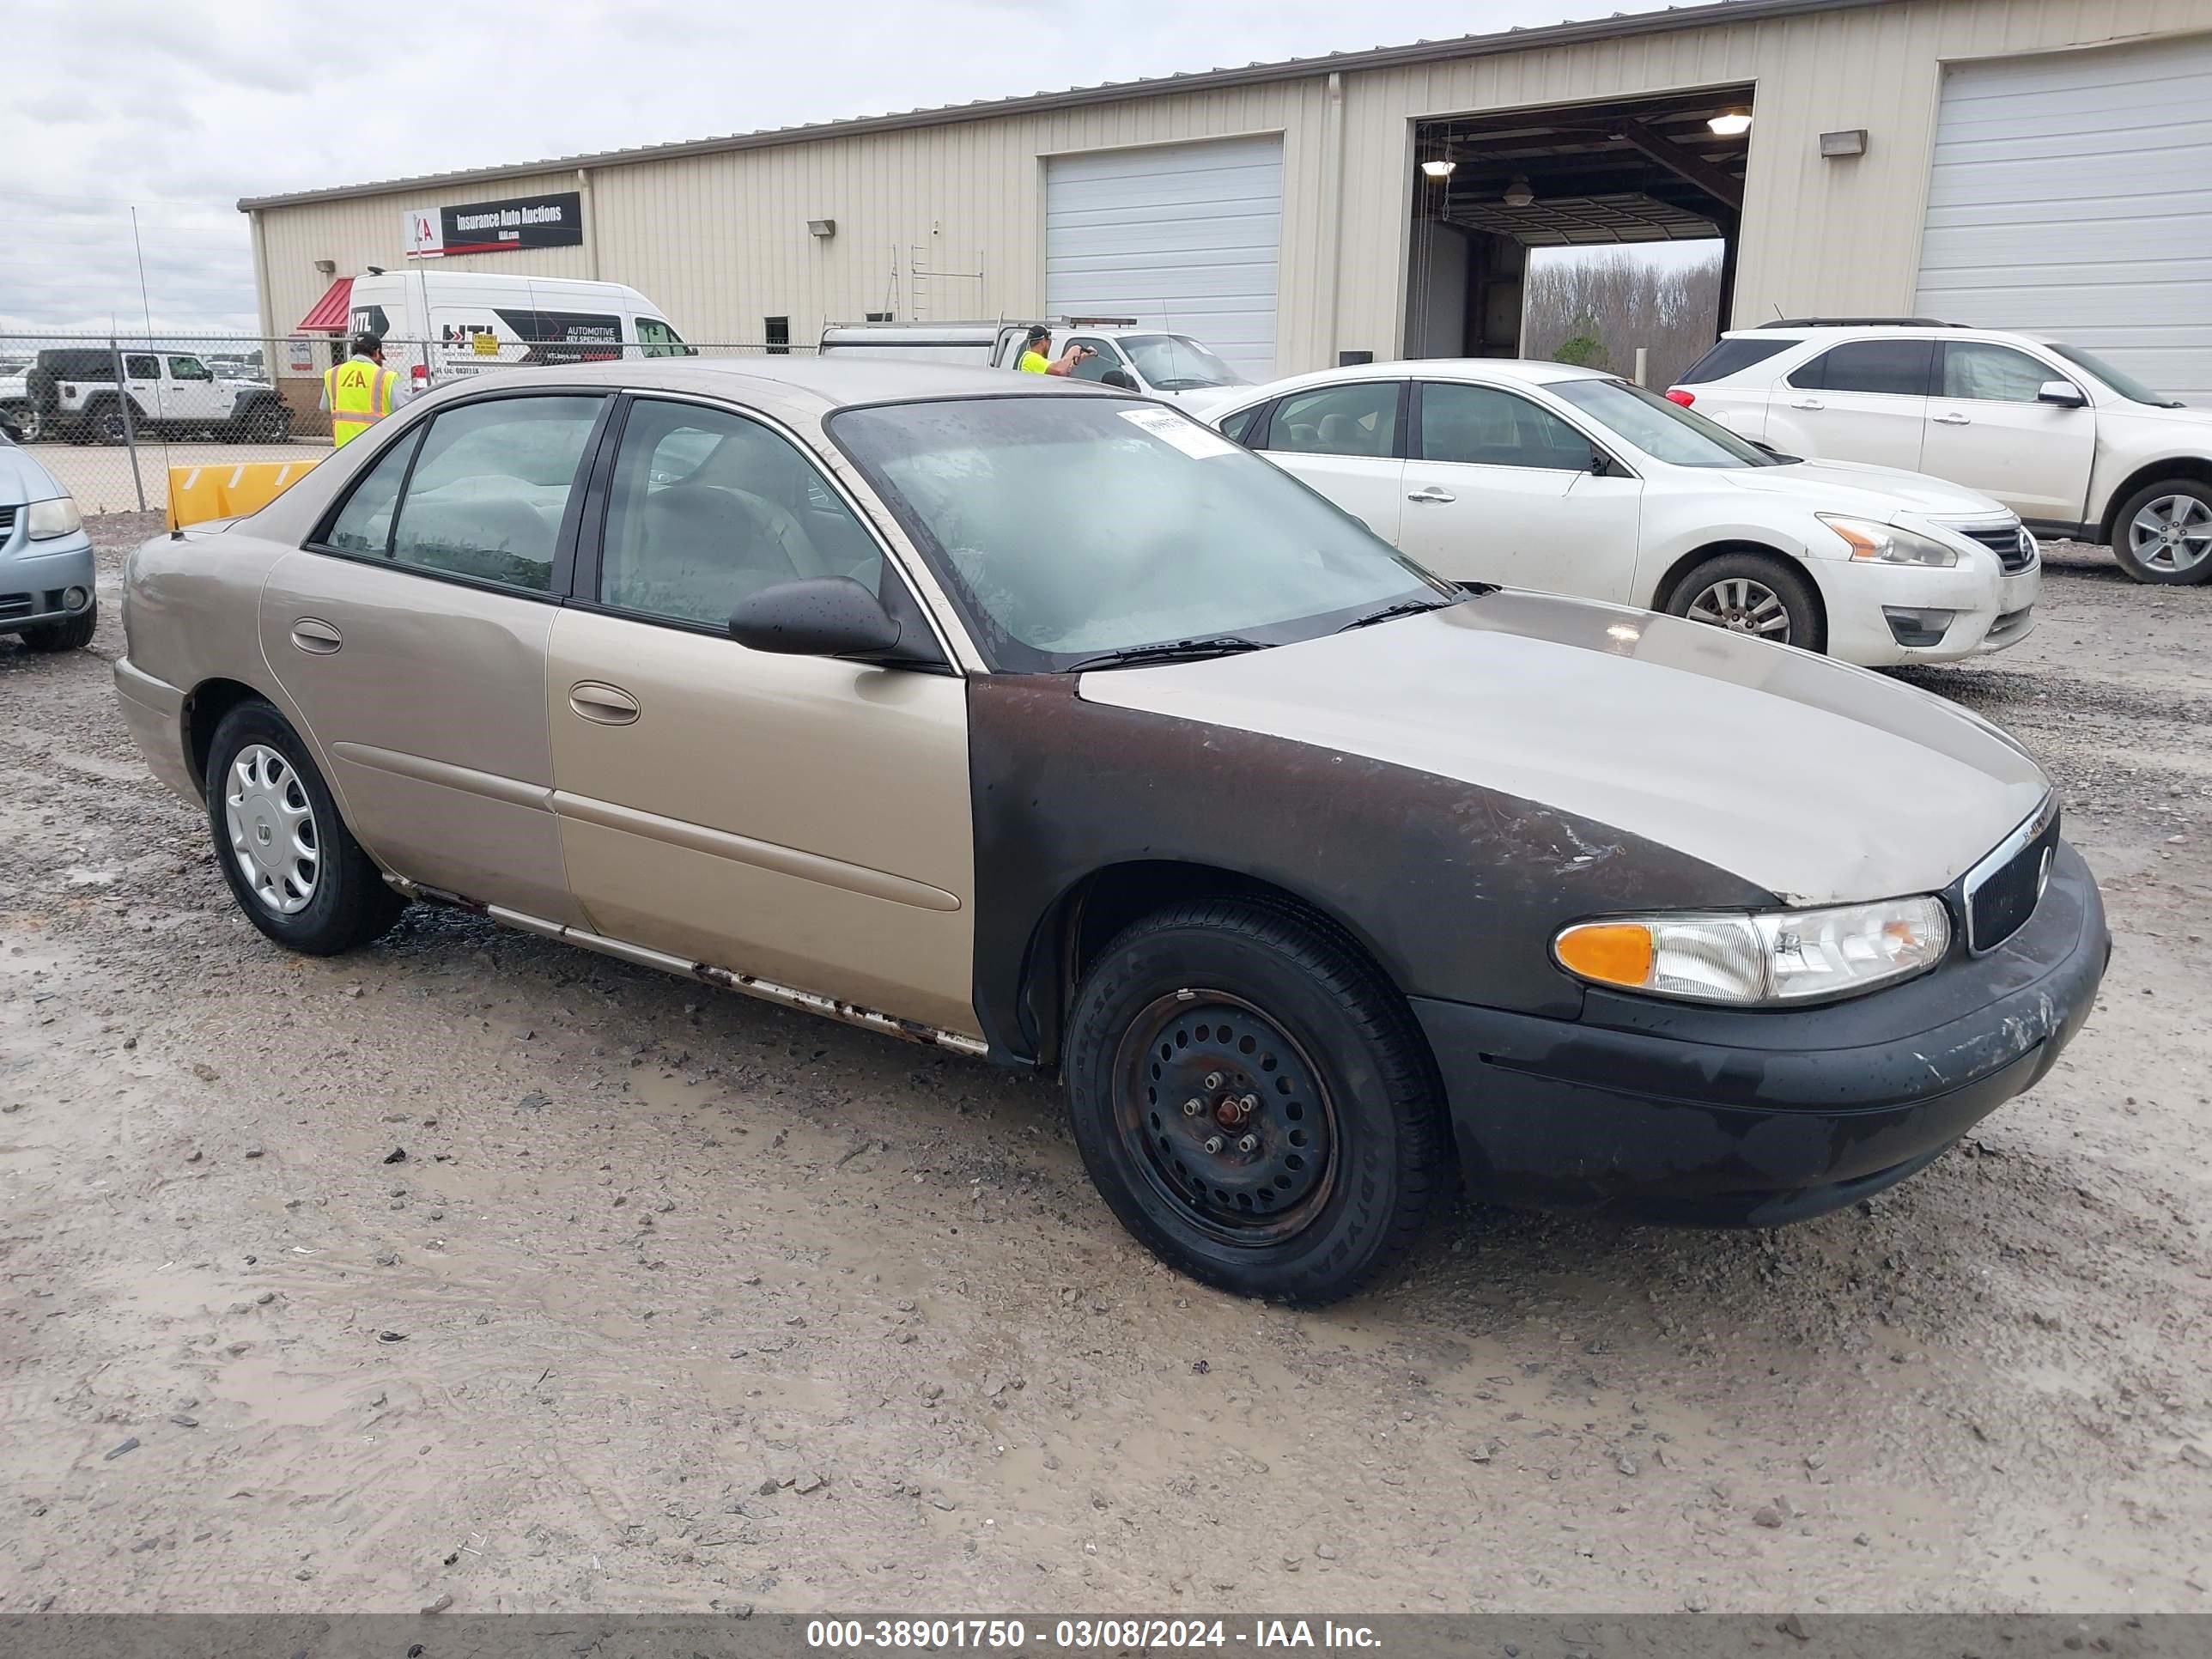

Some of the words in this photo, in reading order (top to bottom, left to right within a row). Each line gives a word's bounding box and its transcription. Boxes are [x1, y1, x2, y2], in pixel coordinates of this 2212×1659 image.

[457, 213, 500, 231] Insurance
[501, 209, 520, 226] Auto
[522, 205, 562, 225] Auctions
[567, 326, 615, 336] AUTOMOTIVE
[567, 335, 577, 343] KEY
